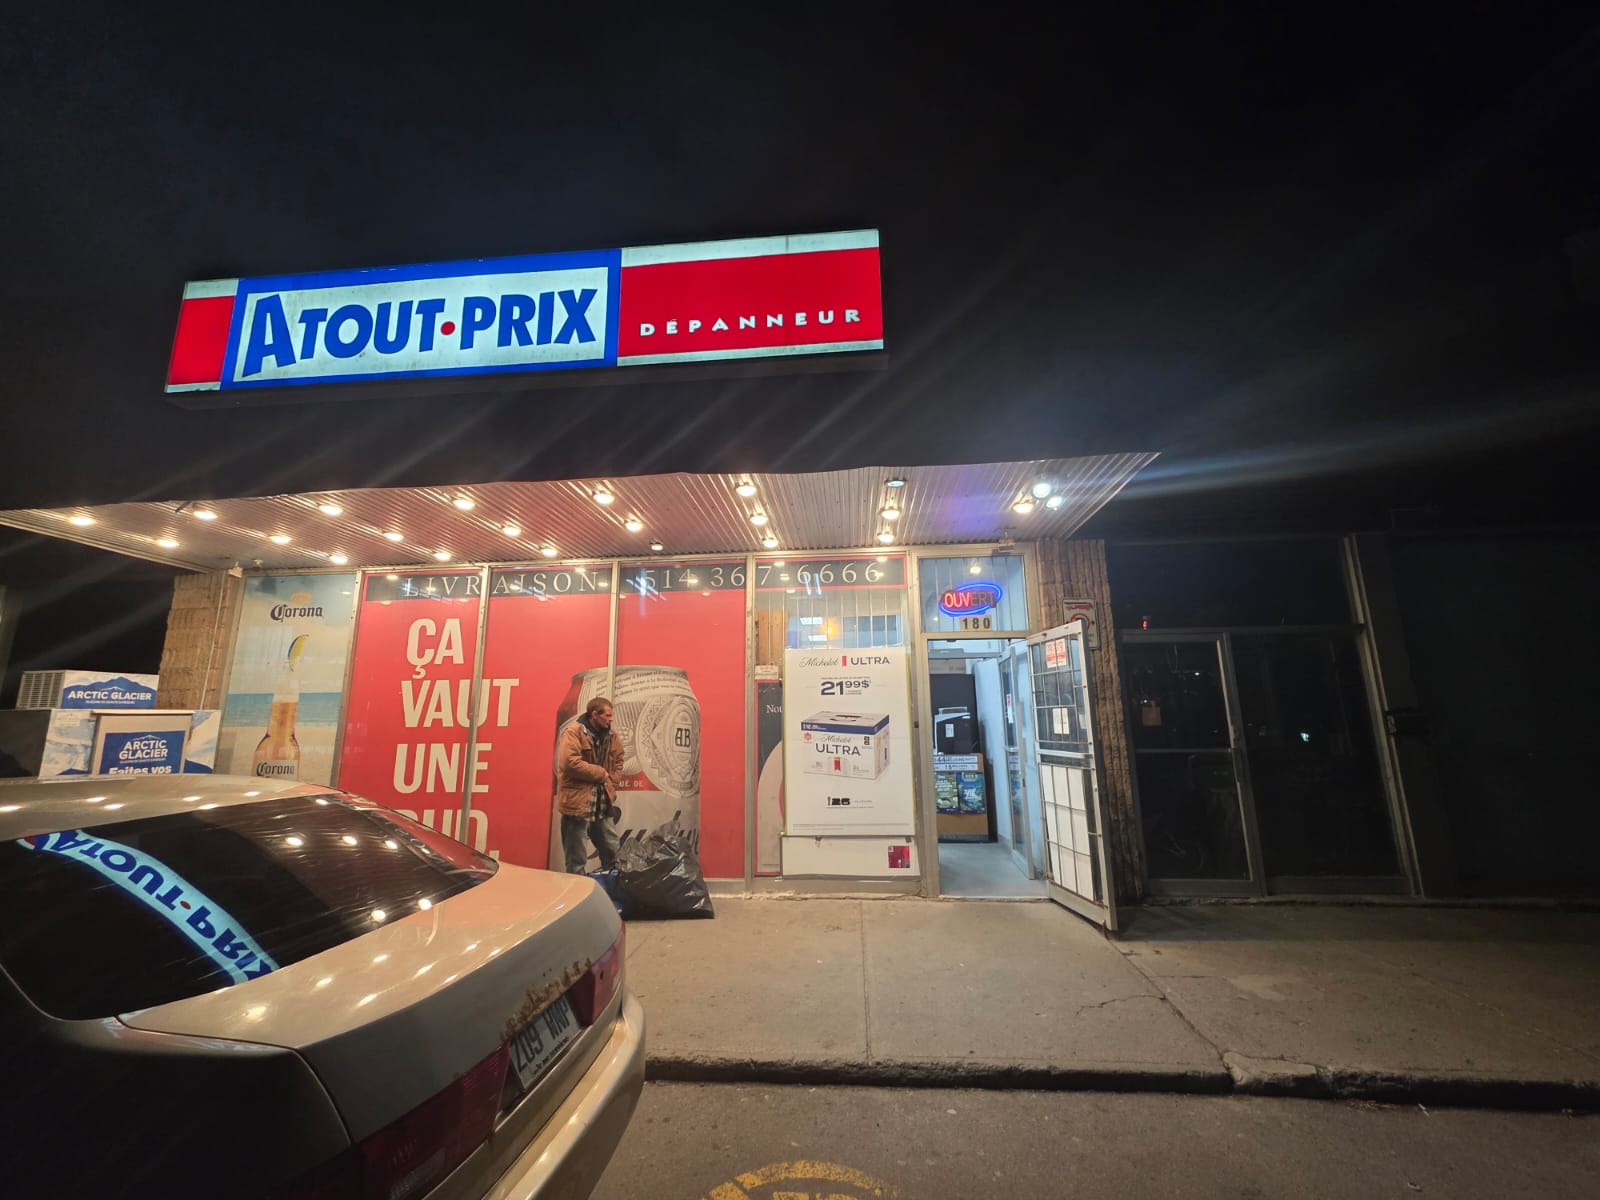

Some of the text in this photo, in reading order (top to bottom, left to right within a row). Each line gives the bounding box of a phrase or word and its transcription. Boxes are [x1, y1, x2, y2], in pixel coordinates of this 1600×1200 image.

[639, 308, 862, 337] DÉPANNEUR
[404, 572, 599, 597] LIVRAISON
[944, 591, 995, 608] OUVERT
[270, 603, 324, 623] Corona
[962, 617, 991, 630] 180
[406, 618, 465, 679] ÇA
[850, 656, 890, 666] ULTRA
[67, 690, 152, 701] ARCTIC GLACIER
[400, 678, 520, 728] VAUT
[123, 739, 167, 751] ARCTIC
[815, 743, 861, 757] ULTRA
[119, 748, 169, 760] GLACIER
[151, 765, 173, 774] vos
[256, 761, 295, 777] Corona
[393, 742, 493, 794] UNE
